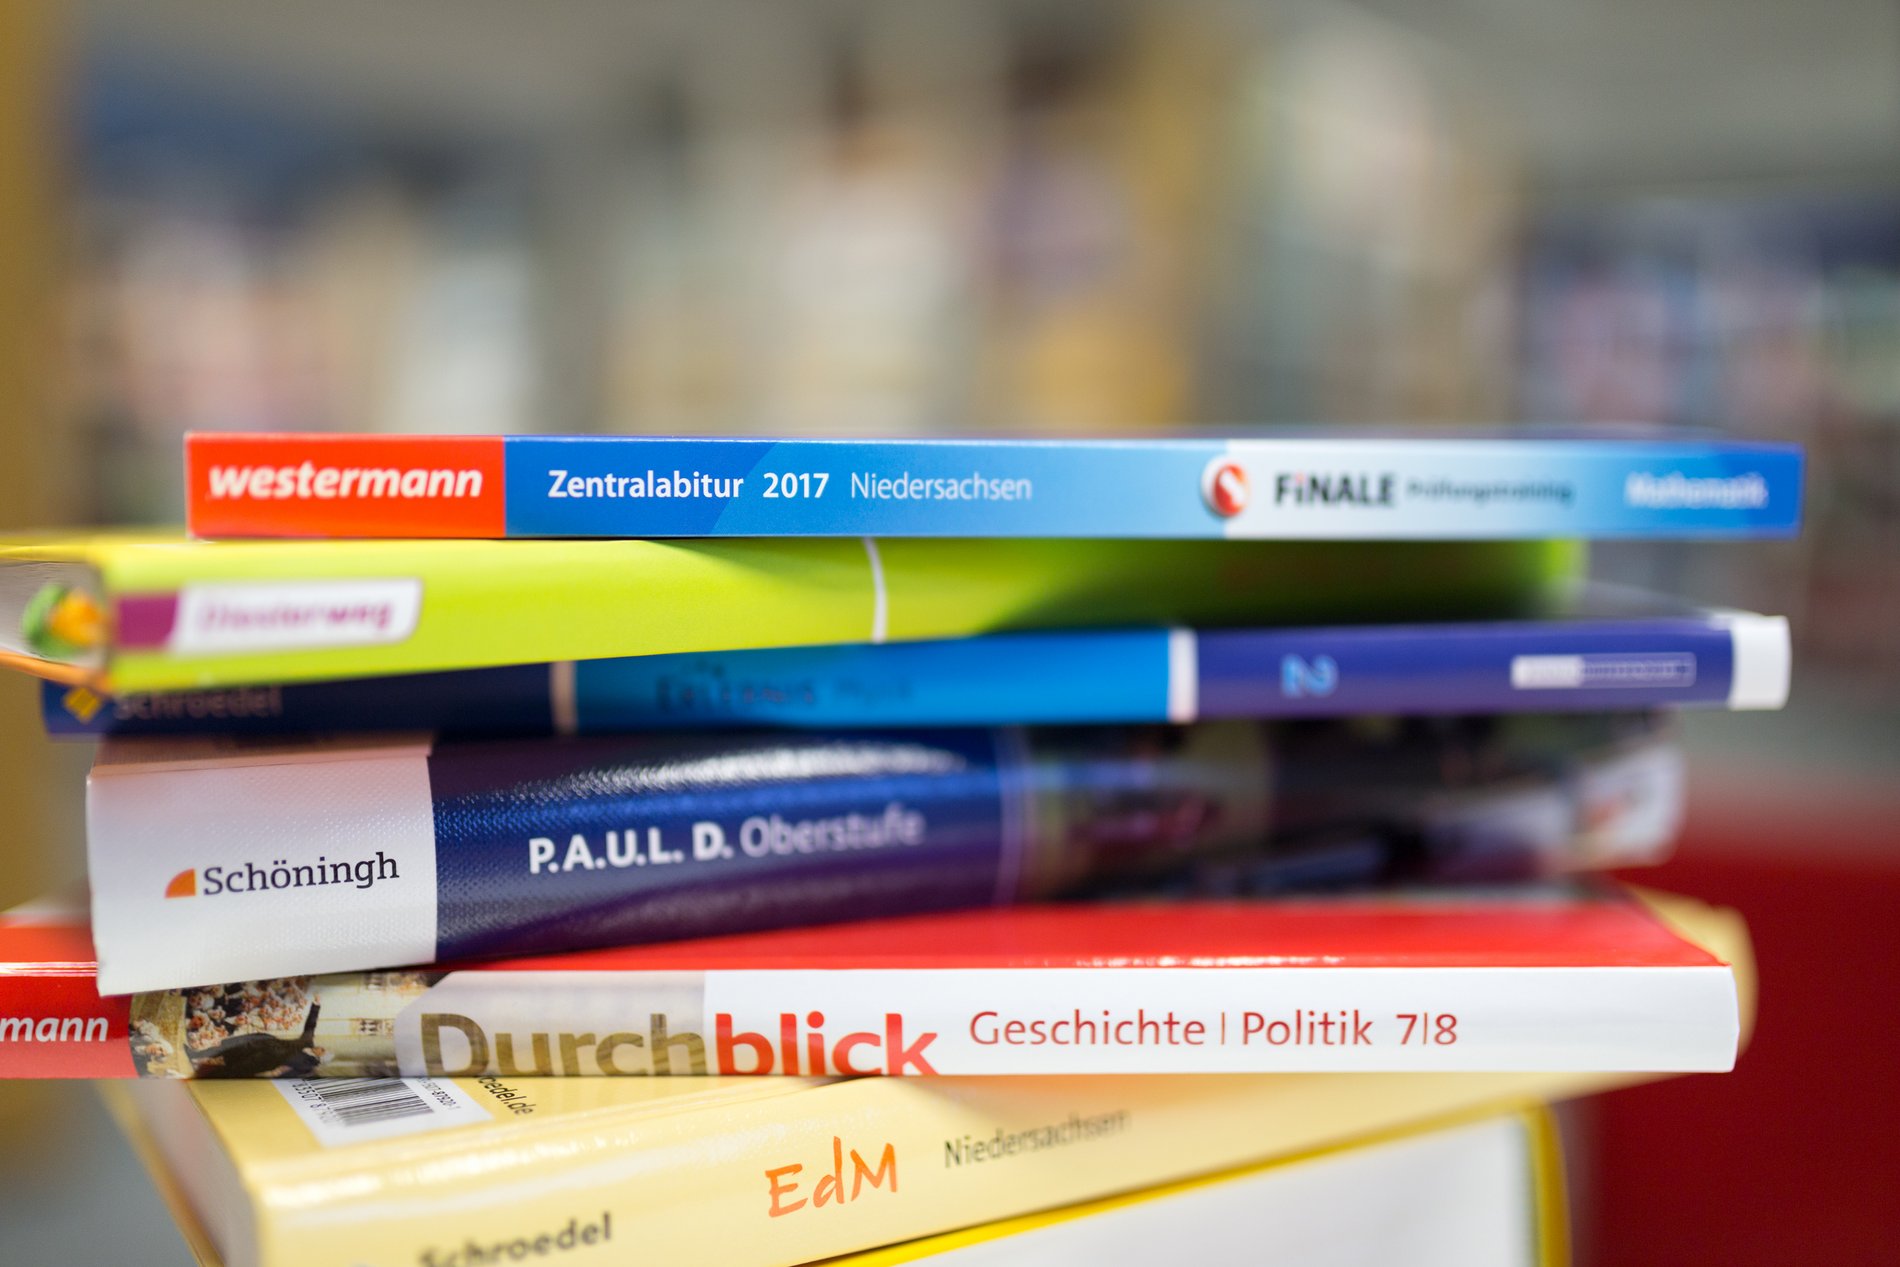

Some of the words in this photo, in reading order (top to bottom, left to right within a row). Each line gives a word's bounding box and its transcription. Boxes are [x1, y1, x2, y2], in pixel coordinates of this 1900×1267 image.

[209, 461, 483, 498] westermann
[548, 469, 744, 498] Zentralabitur
[763, 472, 829, 498] 2017
[850, 472, 1031, 499] Niedersachsen
[1281, 654, 1338, 698] 2
[529, 827, 685, 874] P.A.U.L.
[692, 821, 734, 861] D.
[740, 803, 927, 857] Oberstufe
[203, 851, 400, 896] Schöningh
[420, 1011, 938, 1076] Durchblick
[969, 1009, 1206, 1046] Geschichte
[1242, 1008, 1373, 1046] Politik
[944, 1109, 1131, 1168] Niedersachsen
[765, 1136, 898, 1218] EdM
